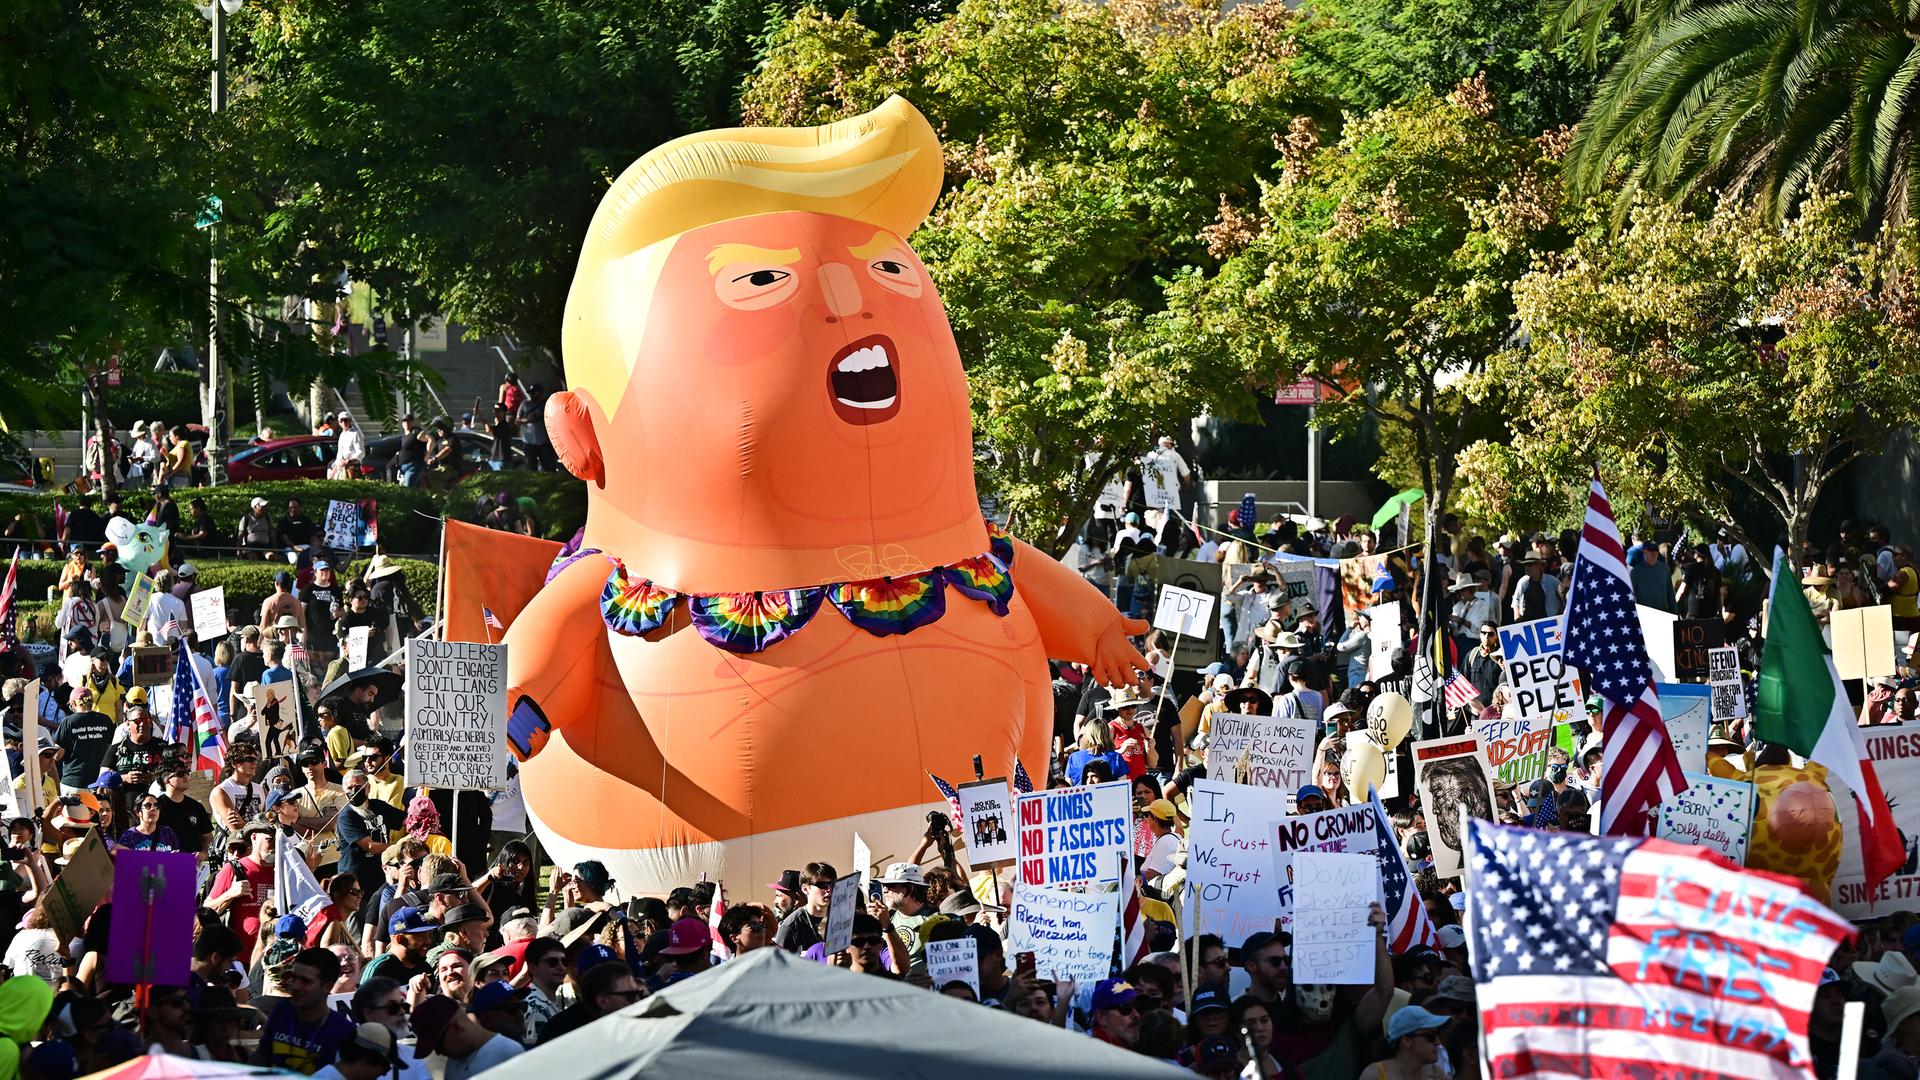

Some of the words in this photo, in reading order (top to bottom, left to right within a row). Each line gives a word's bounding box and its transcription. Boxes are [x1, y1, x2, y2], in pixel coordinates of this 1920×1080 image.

[1298, 388, 1314, 398] PARK
[336, 502, 354, 511] STO
[1163, 590, 1207, 618] FDT
[1500, 618, 1561, 660] WE
[1681, 625, 1704, 644] NO
[416, 640, 498, 661] SOLDIERS
[1676, 648, 1708, 670] KING
[1710, 651, 1736, 670] EFEND
[416, 659, 453, 675] DON'T
[456, 661, 499, 679] ENGAGE
[1509, 654, 1566, 688] PEO
[417, 675, 498, 694] CIVILIANS
[1729, 684, 1741, 695] FOR
[423, 692, 446, 710] IN
[454, 693, 487, 712] OUR
[72, 726, 87, 734] Build
[87, 725, 108, 733] Bridges
[417, 709, 494, 729] COUNTRY!
[1214, 718, 1261, 739] NOTHING
[1264, 725, 1272, 737] IS
[1273, 726, 1306, 740] MORE
[1369, 715, 1387, 732] EDO
[1513, 720, 1531, 736] UR
[410, 728, 496, 744] ADMIRALS/GENERALS
[1213, 736, 1304, 757] AMERICAN
[414, 751, 430, 761] GET
[432, 752, 446, 761] OFF
[447, 752, 466, 762] YOUR
[466, 752, 494, 762] KNEES!
[1486, 738, 1517, 768] NDS
[1866, 733, 1920, 762] KINGS
[419, 760, 493, 775] DEMOCRACY
[1215, 766, 1225, 781] A
[1232, 764, 1306, 789] YRANT
[1498, 751, 1546, 786] MOUTH
[462, 775, 498, 789] STAKE!
[970, 803, 1001, 812] DIDDLERS
[1021, 798, 1042, 826] NO
[1046, 792, 1093, 823] KINGS
[1199, 790, 1235, 824] In
[1682, 800, 1711, 816] BORN
[1278, 819, 1310, 853] NO
[1315, 807, 1376, 842] CROWNS
[1707, 817, 1719, 829] TO
[1022, 828, 1043, 857] NO
[1047, 817, 1125, 853] FASCISTS
[1221, 828, 1269, 850] Crust
[1194, 843, 1218, 868] We
[1022, 858, 1044, 886] NO
[1048, 852, 1097, 883] NAZIS
[1219, 863, 1261, 884] Trust
[1188, 881, 1239, 902] NOT
[1894, 876, 1920, 900] 177
[1650, 864, 1818, 947] KING
[1028, 924, 1088, 941] Venezuela
[597, 945, 608, 957] LA
[930, 943, 943, 953] NO
[965, 940, 976, 948] IS
[962, 952, 974, 960] ON
[1012, 934, 1038, 953] We
[1040, 944, 1057, 956] do
[1064, 947, 1084, 959] not
[1296, 943, 1366, 971] RESIST
[1635, 928, 1791, 1000] FREE
[1640, 999, 1712, 1034] NCE
[1727, 1016, 1798, 1060] 177
